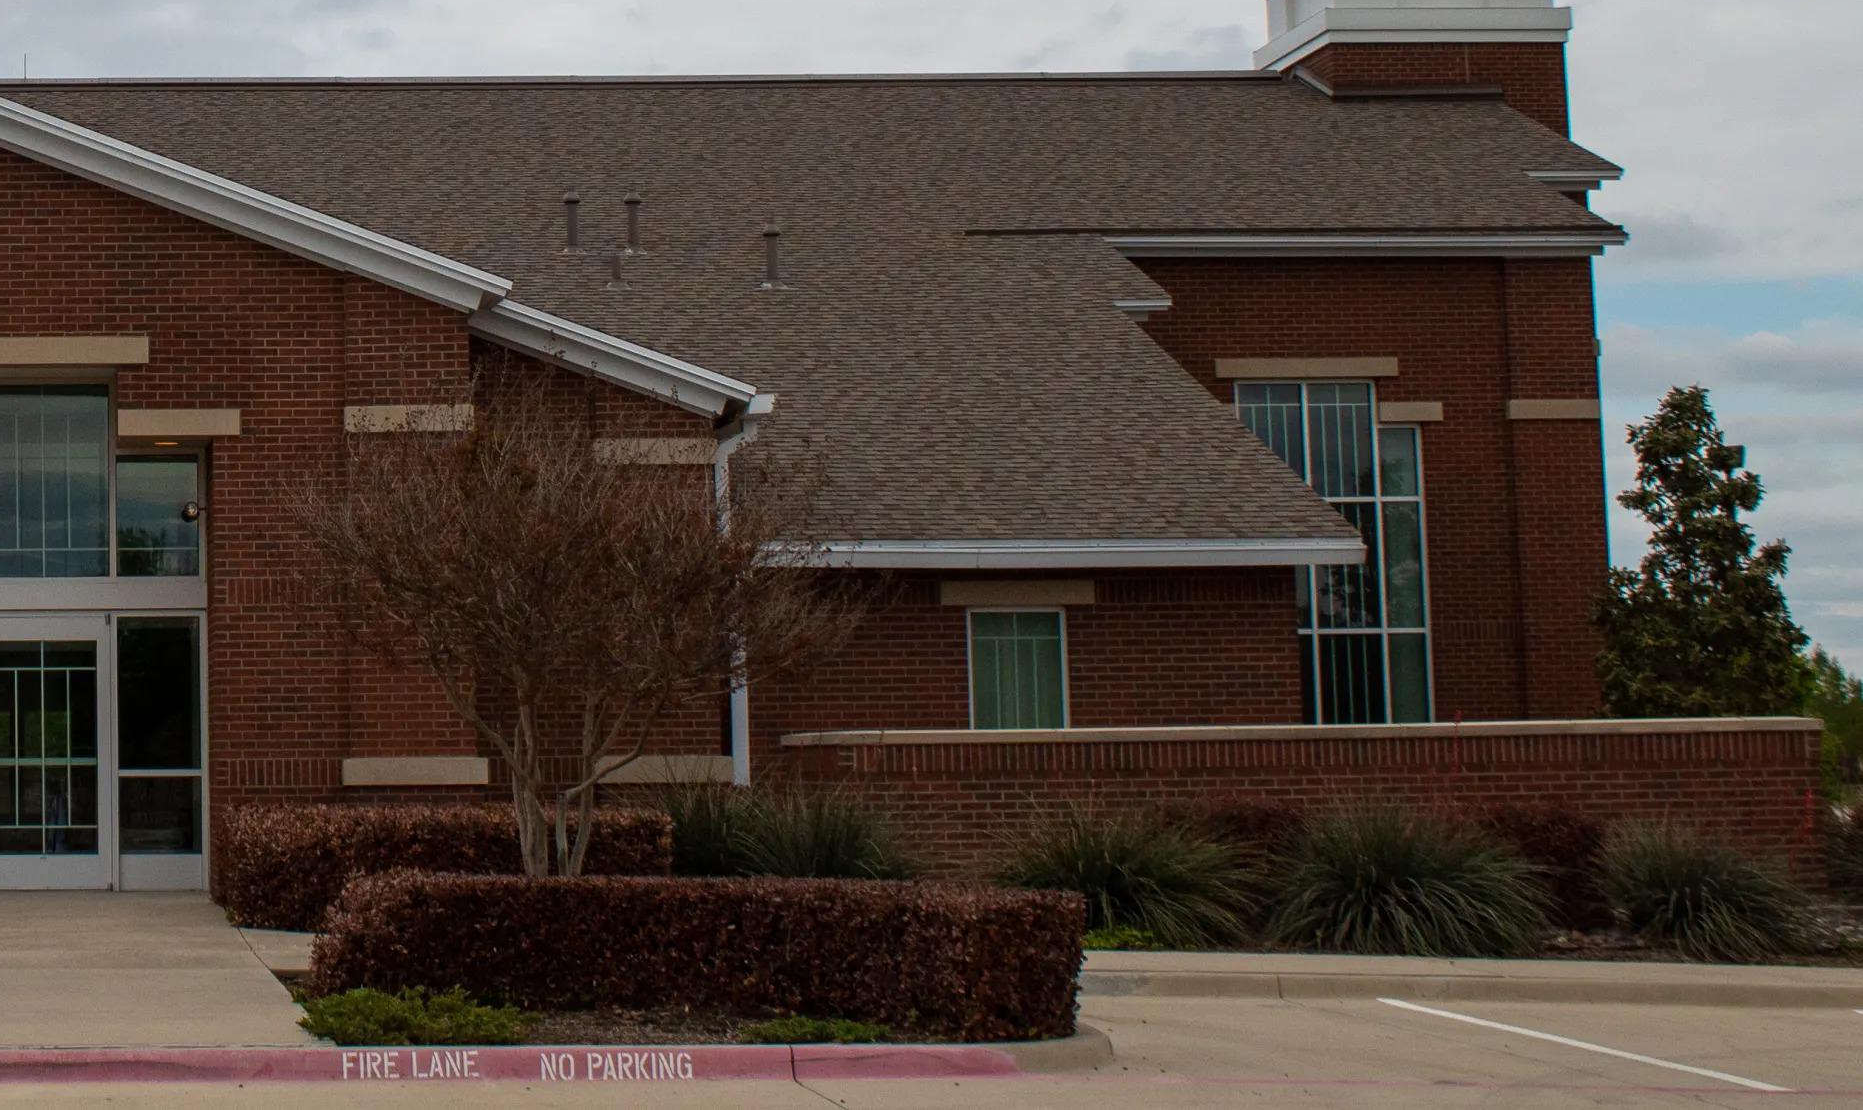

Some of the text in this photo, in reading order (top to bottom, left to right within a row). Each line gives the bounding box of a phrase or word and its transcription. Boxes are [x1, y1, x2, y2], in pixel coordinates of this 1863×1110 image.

[342, 1050, 693, 1081] FIRE LANE NO PARKING
